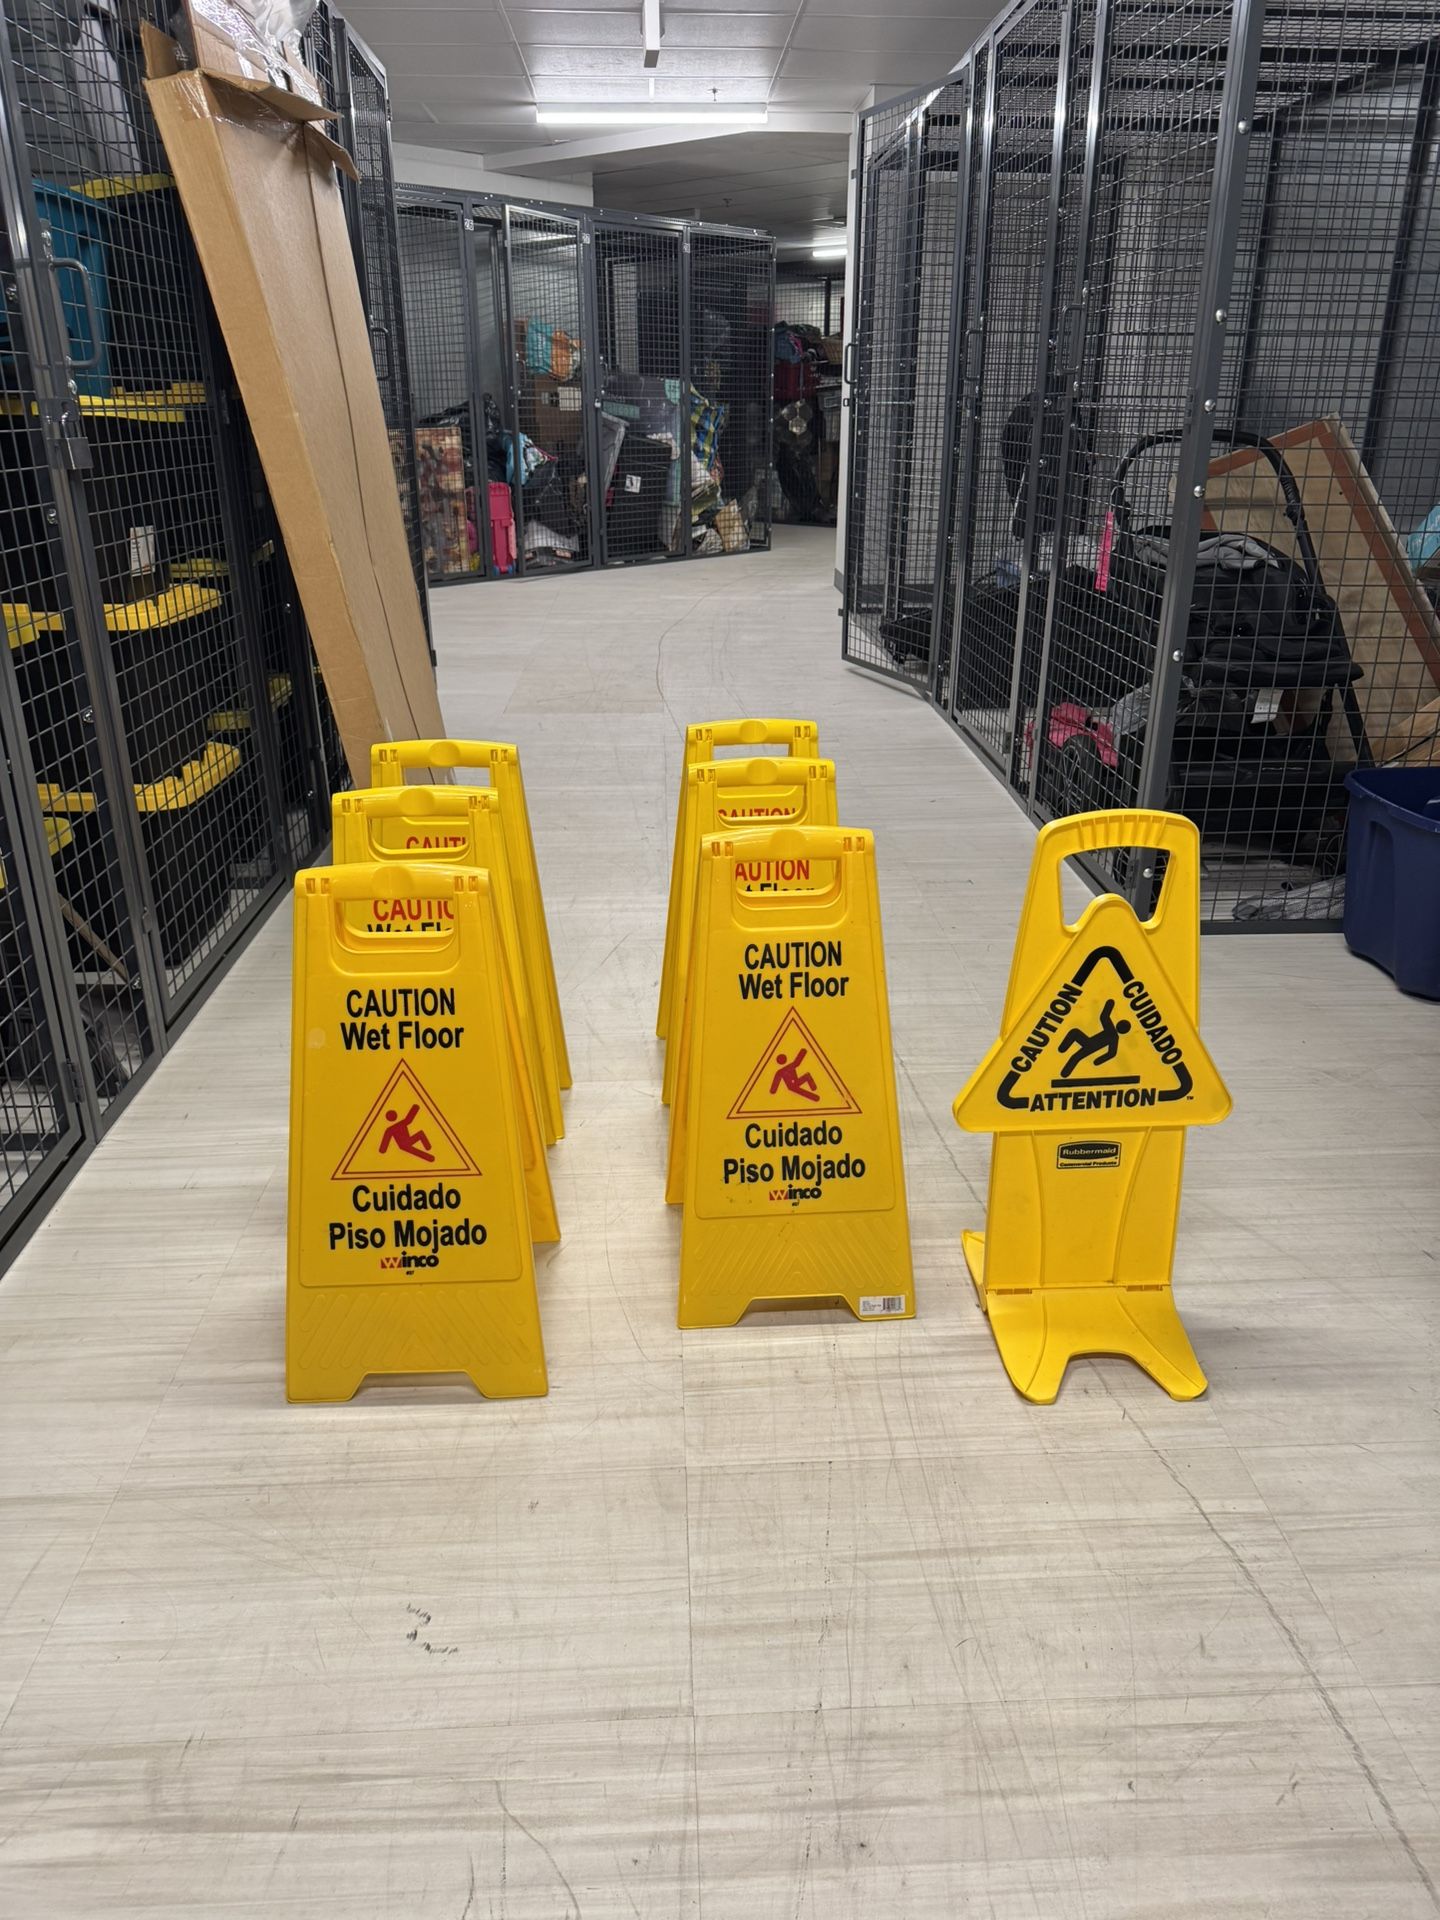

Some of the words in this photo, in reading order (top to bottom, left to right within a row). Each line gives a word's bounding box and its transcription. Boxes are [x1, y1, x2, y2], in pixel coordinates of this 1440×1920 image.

[735, 859, 810, 882] AUTION
[373, 899, 454, 922] CAUTIO
[745, 941, 841, 970] CAUTION
[739, 973, 782, 999] Wet
[790, 972, 849, 998] Floor
[347, 988, 455, 1018] CAUTION
[340, 1022, 390, 1050] Wet
[398, 1021, 464, 1049] Floor
[1011, 983, 1083, 1073] CAUTION
[1123, 981, 1183, 1065] CUIDADO
[1029, 1088, 1157, 1112] ATTENTION
[745, 1120, 842, 1148] Cuidado
[1062, 1146, 1117, 1156] Rubbermaid
[724, 1158, 774, 1184] Piso
[782, 1153, 865, 1187] Mojado
[353, 1182, 461, 1212] Cuidado
[329, 1222, 386, 1250] Piso
[394, 1218, 487, 1254] Mojado
